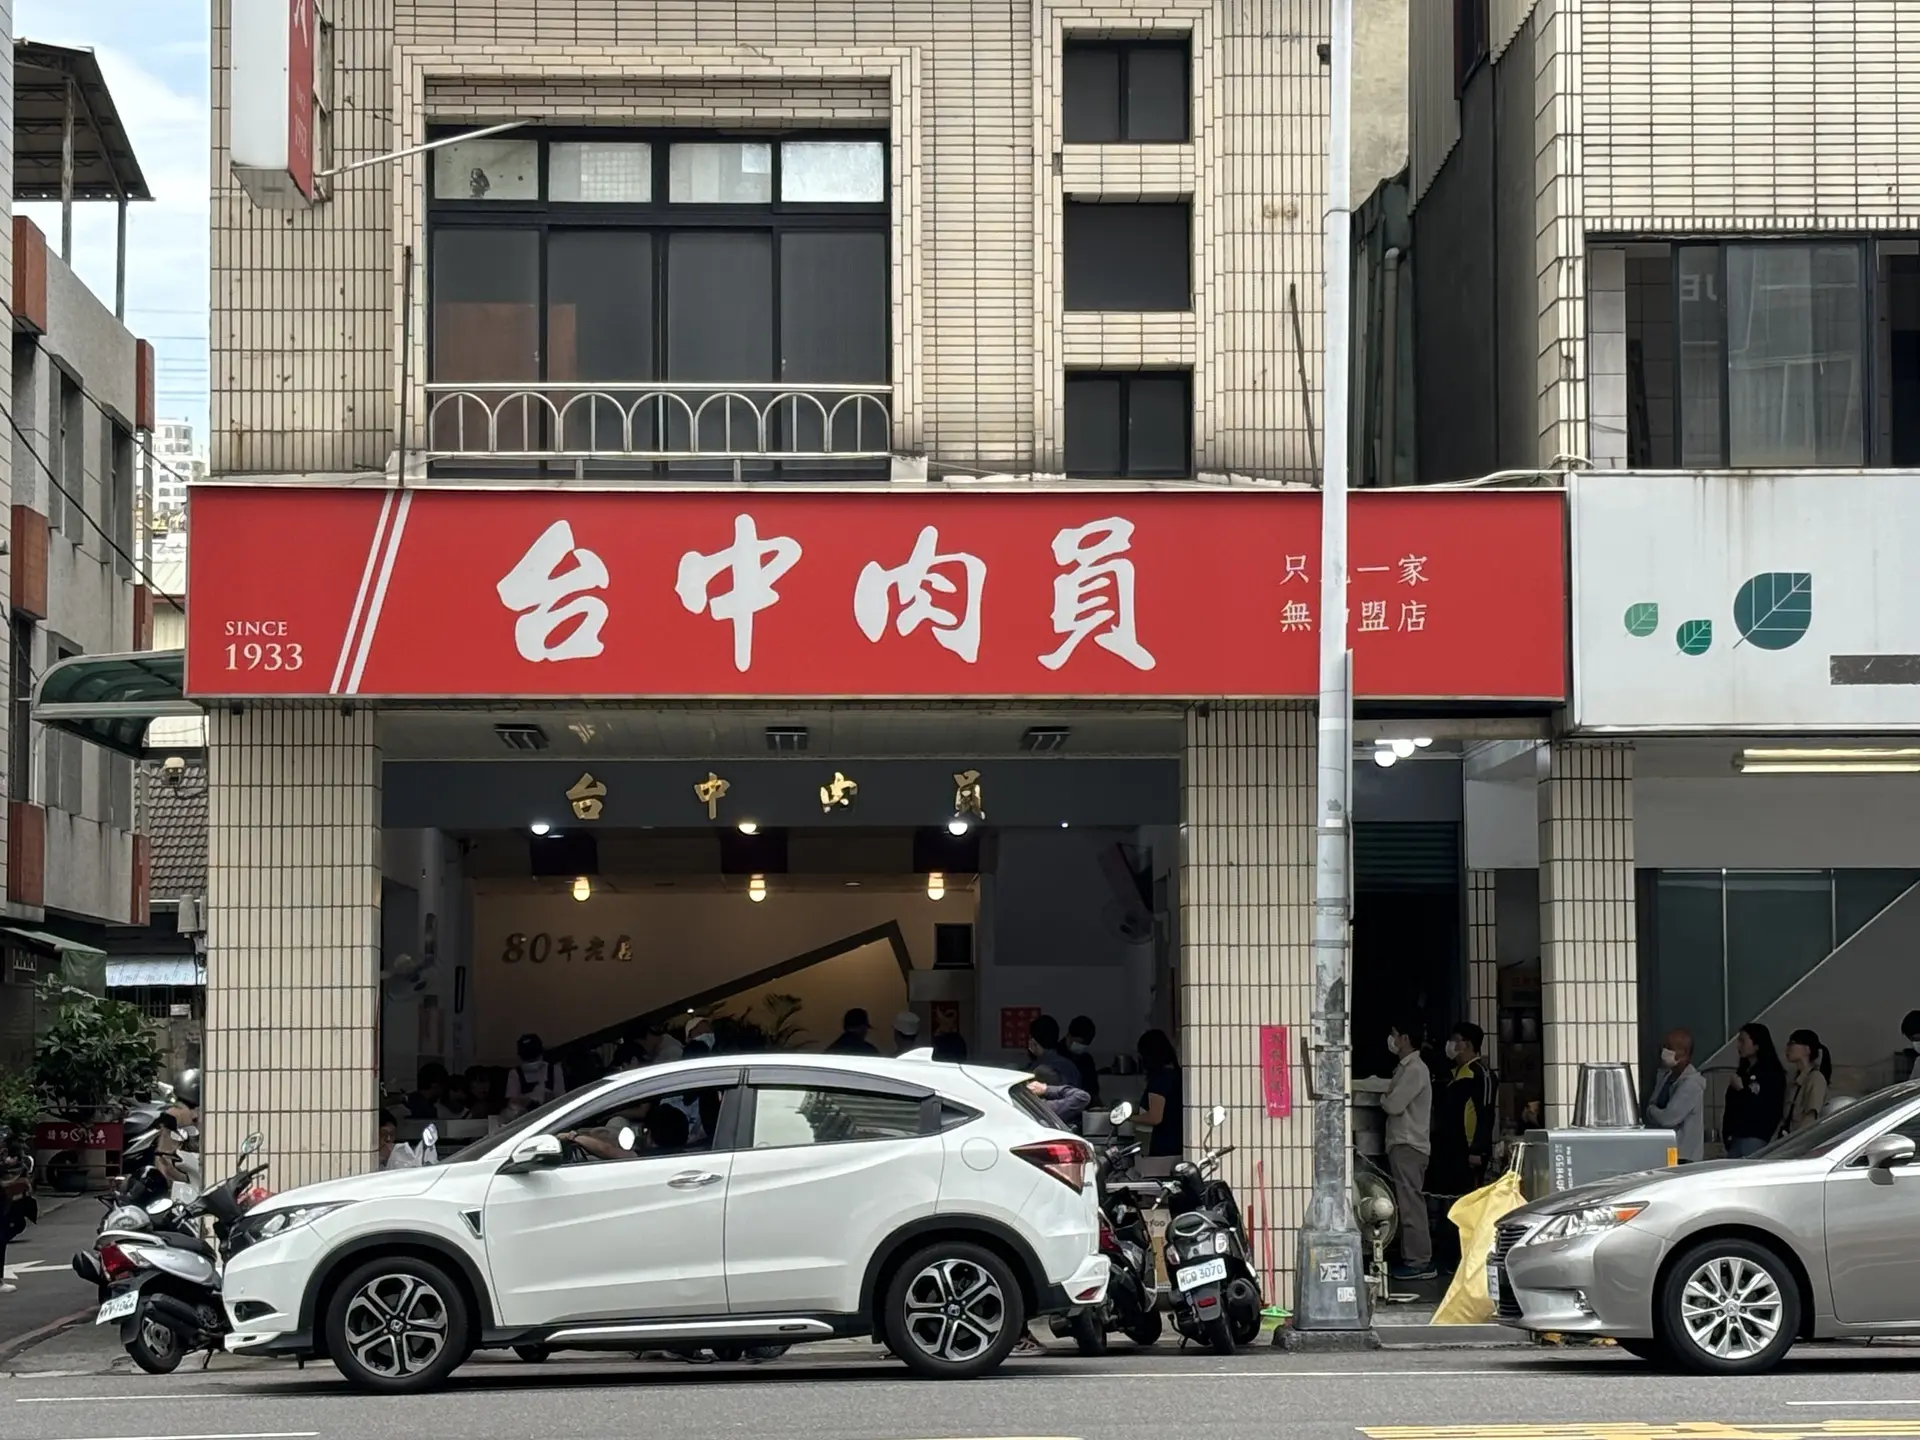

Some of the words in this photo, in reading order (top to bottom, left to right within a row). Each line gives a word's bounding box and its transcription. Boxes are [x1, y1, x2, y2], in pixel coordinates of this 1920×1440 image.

[1279, 553, 1430, 587] 只一家
[496, 513, 1157, 673] 台中肉員
[225, 620, 288, 638] SINCE
[1279, 599, 1428, 633] 無盟店
[225, 642, 304, 671] 1933
[501, 932, 634, 964] 80年老店
